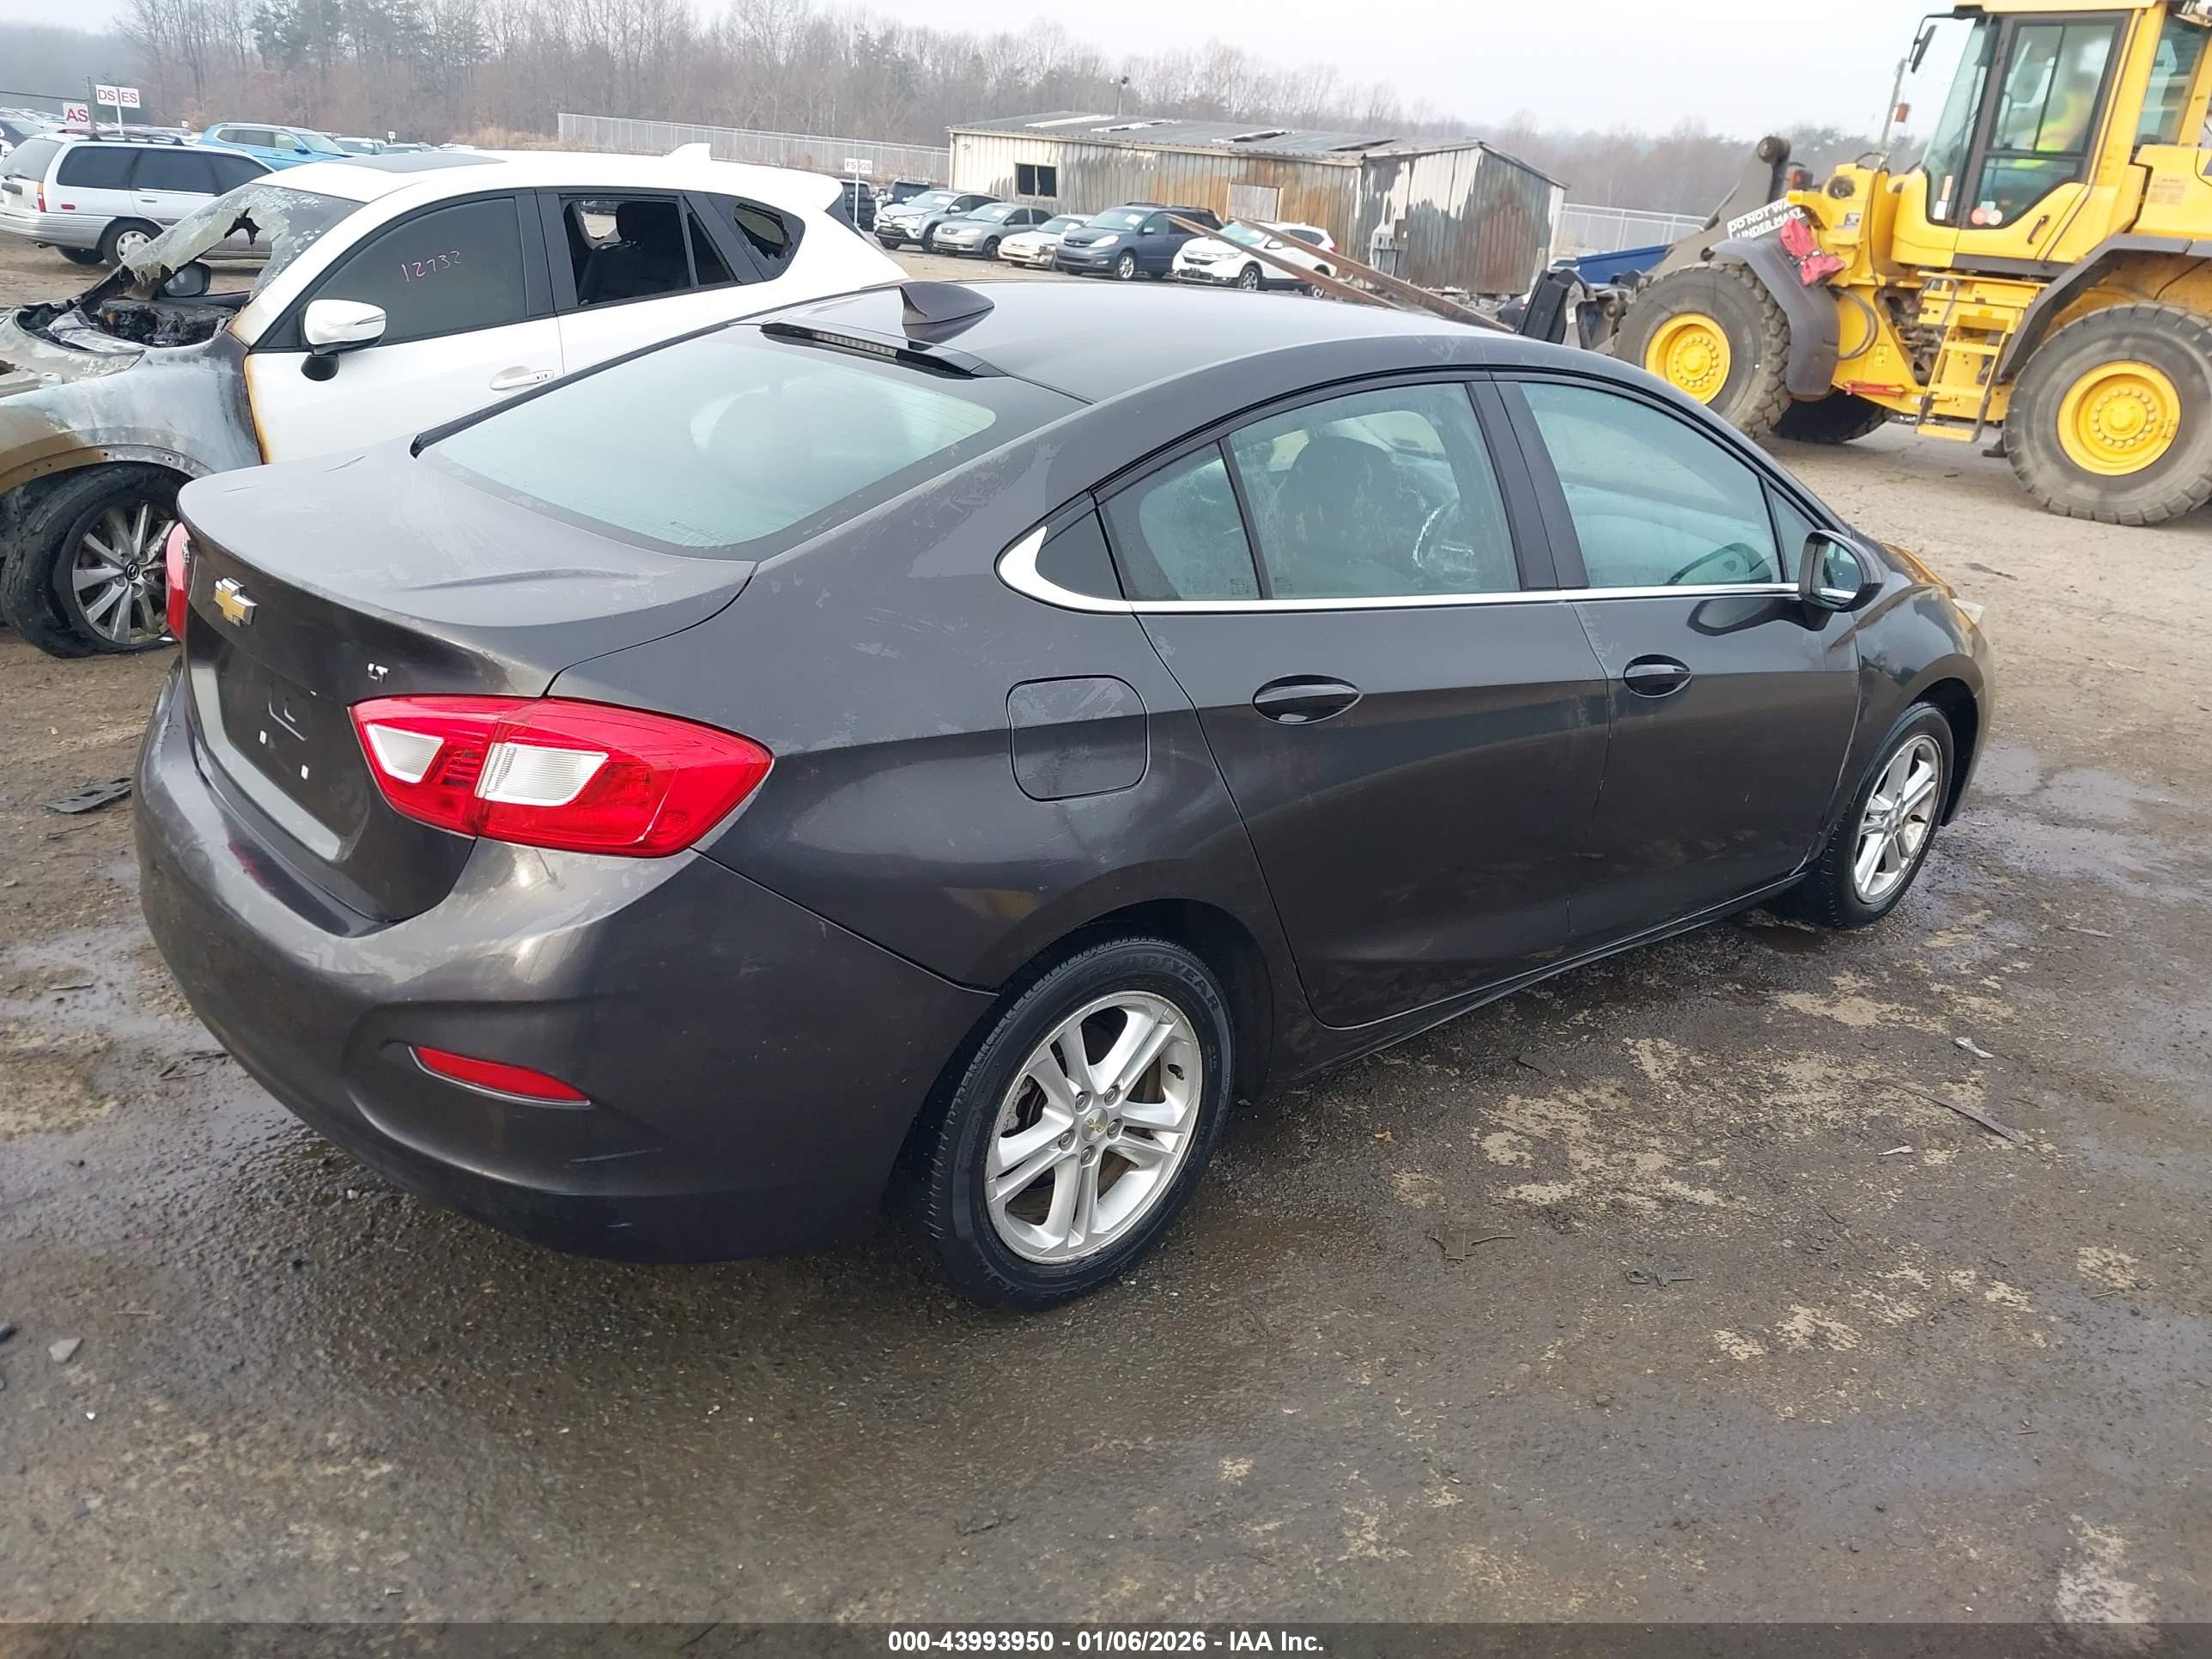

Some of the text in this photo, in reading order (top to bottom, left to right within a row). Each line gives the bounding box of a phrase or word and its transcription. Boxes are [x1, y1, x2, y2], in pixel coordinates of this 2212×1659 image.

[97, 89, 116, 101] DS
[121, 92, 137, 104] ES
[67, 108, 88, 123] AS
[846, 161, 856, 170] FS
[1728, 218, 1747, 233] DO
[1747, 208, 1770, 225] NOT
[401, 250, 461, 283] 12732
[368, 663, 388, 684] LT
